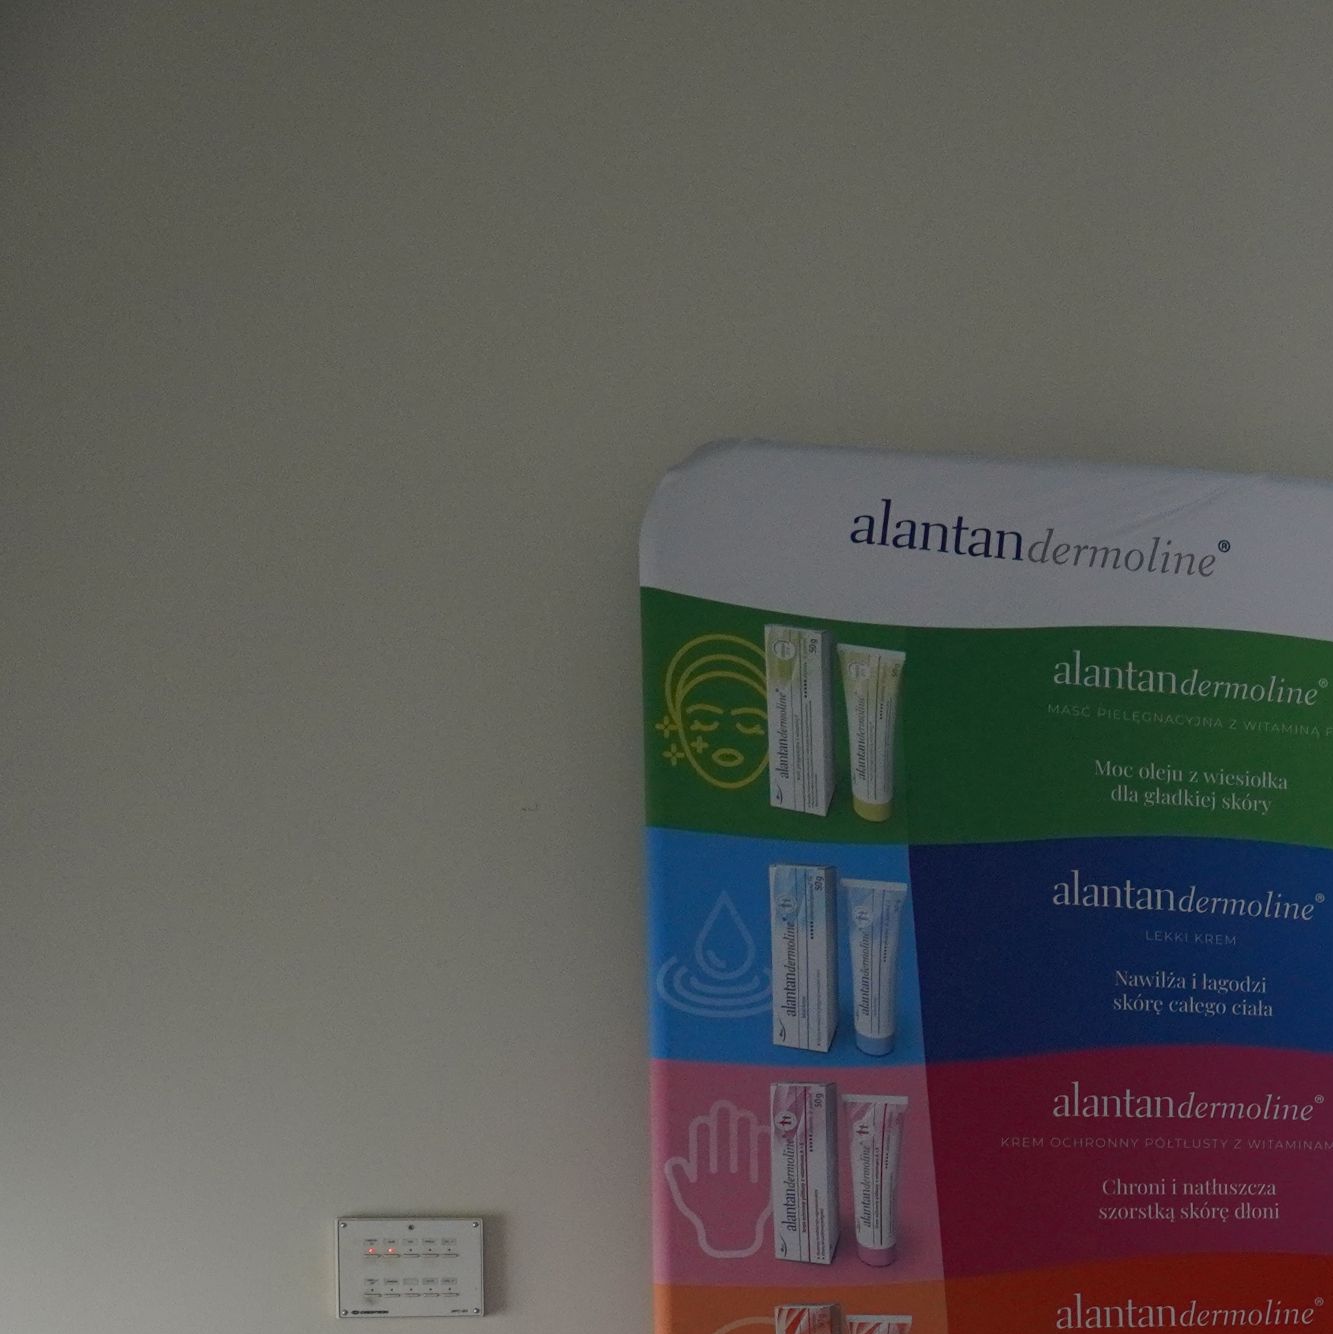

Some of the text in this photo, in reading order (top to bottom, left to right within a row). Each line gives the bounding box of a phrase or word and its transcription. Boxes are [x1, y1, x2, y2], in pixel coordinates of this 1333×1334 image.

[1229, 718, 1239, 730] Z
[1095, 760, 1288, 791] Moc oleju z wiesiołka
[1111, 784, 1272, 816] dla gładkiej skóry
[1144, 929, 1237, 946] LEKKI KREM
[1115, 970, 1268, 994] Nawilża i łagodzi
[1113, 993, 1274, 1018] skórę całego ciała
[1000, 1136, 1045, 1149] KREM
[1050, 1136, 1138, 1149] OCHRONNY
[1145, 1133, 1228, 1151] PÓŁTŁUSTY
[1233, 1138, 1242, 1150] Z
[1101, 1178, 1277, 1198] Chroni i natłuszcza
[1097, 1199, 1281, 1224] szorstką skórę dłoni
